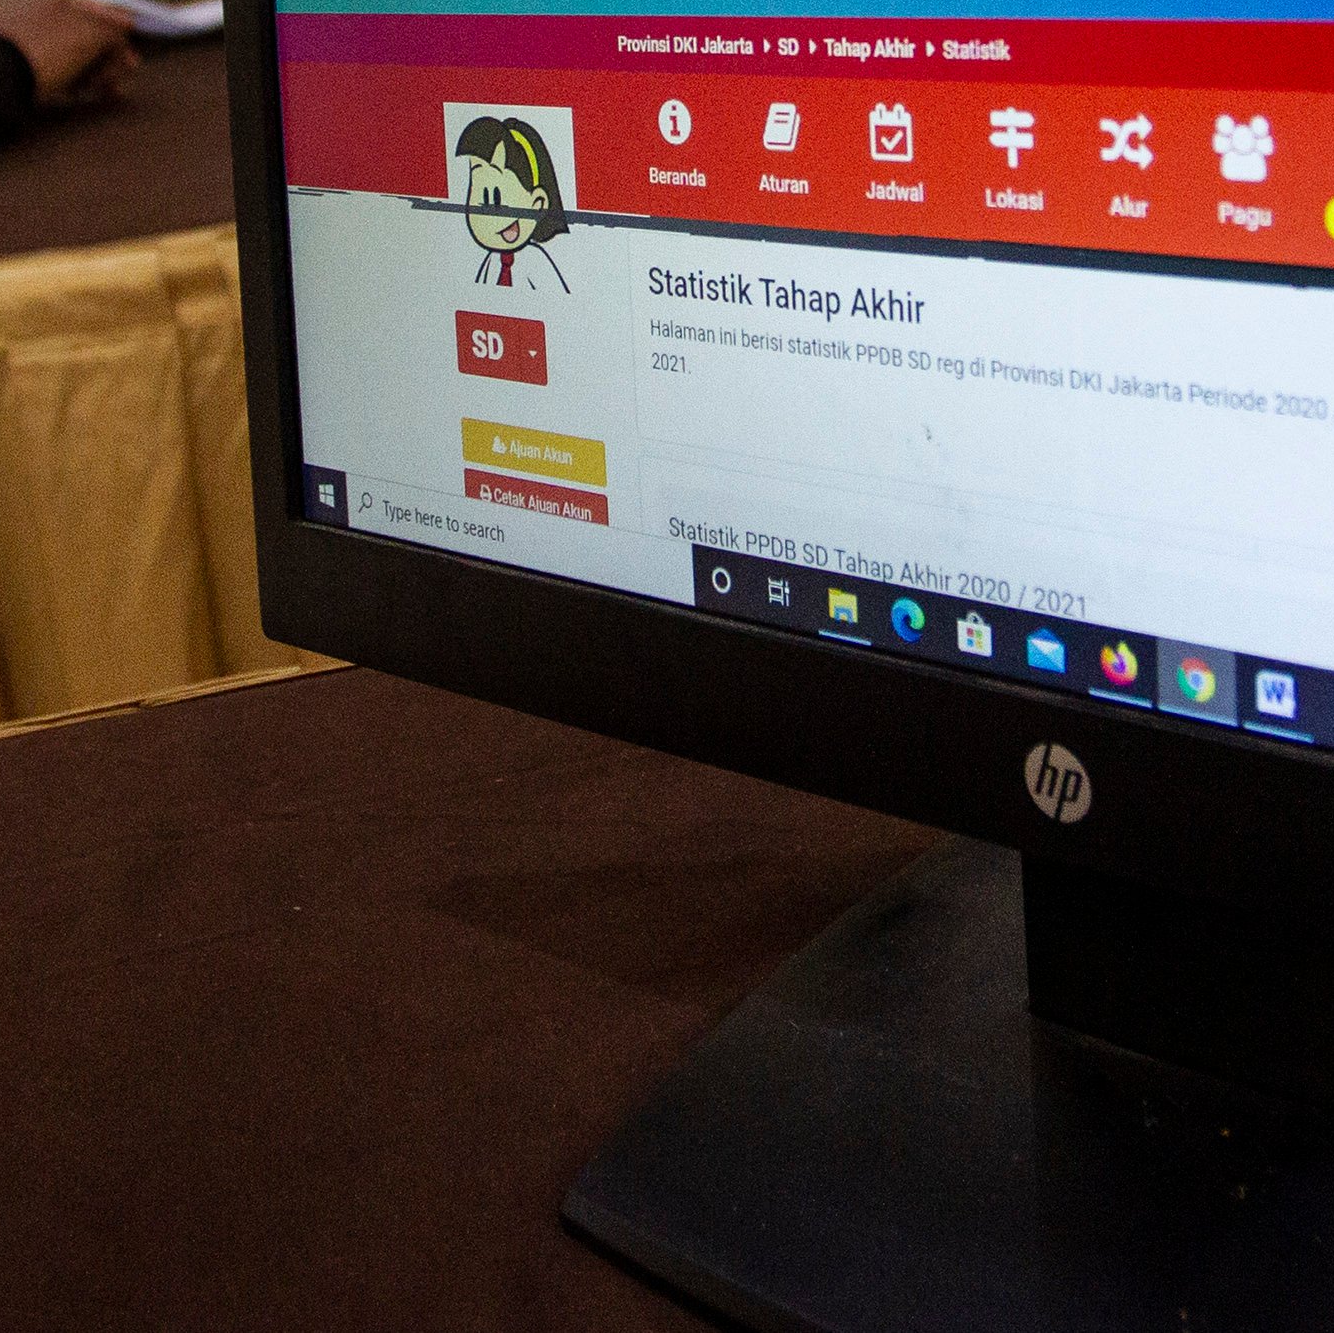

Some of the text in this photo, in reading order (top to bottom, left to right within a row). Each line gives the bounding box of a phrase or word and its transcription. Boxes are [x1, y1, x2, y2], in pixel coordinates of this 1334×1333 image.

[617, 34, 1011, 61] Provinsi DKI Jakarta SD Tahap Akhir Statistik
[648, 167, 707, 188] Beranda
[758, 174, 810, 196] Aturan
[866, 180, 926, 204] Jadwal
[984, 188, 1045, 213] Lokasi
[1108, 195, 1151, 219] Alur
[648, 267, 926, 324] Statistik Tahap Akhir
[471, 328, 505, 361] SD
[650, 319, 716, 345] Halaman
[719, 326, 737, 347] ini
[741, 328, 784, 353] berisi
[787, 334, 853, 362] statistik
[856, 343, 904, 368] PPDB
[907, 350, 932, 372] SD
[935, 357, 965, 381] reg
[969, 356, 987, 379] di
[990, 359, 1065, 389] Provinsi
[1069, 368, 1103, 395] DKI
[1107, 374, 1185, 404] Jakarta
[1187, 383, 1269, 414] Periode
[509, 439, 573, 465] Ajuan Akun
[493, 487, 593, 521] Cetak Ajuan Akun
[382, 499, 505, 544] Type here to search
[668, 516, 741, 551] Statistik
[745, 531, 798, 562] PPDB
[802, 542, 829, 567] SD
[833, 549, 894, 583] Tahap
[900, 562, 953, 593] Akhir
[958, 572, 1012, 606] 2020
[1033, 586, 1088, 620] 2021
[1029, 743, 1088, 822] hp
